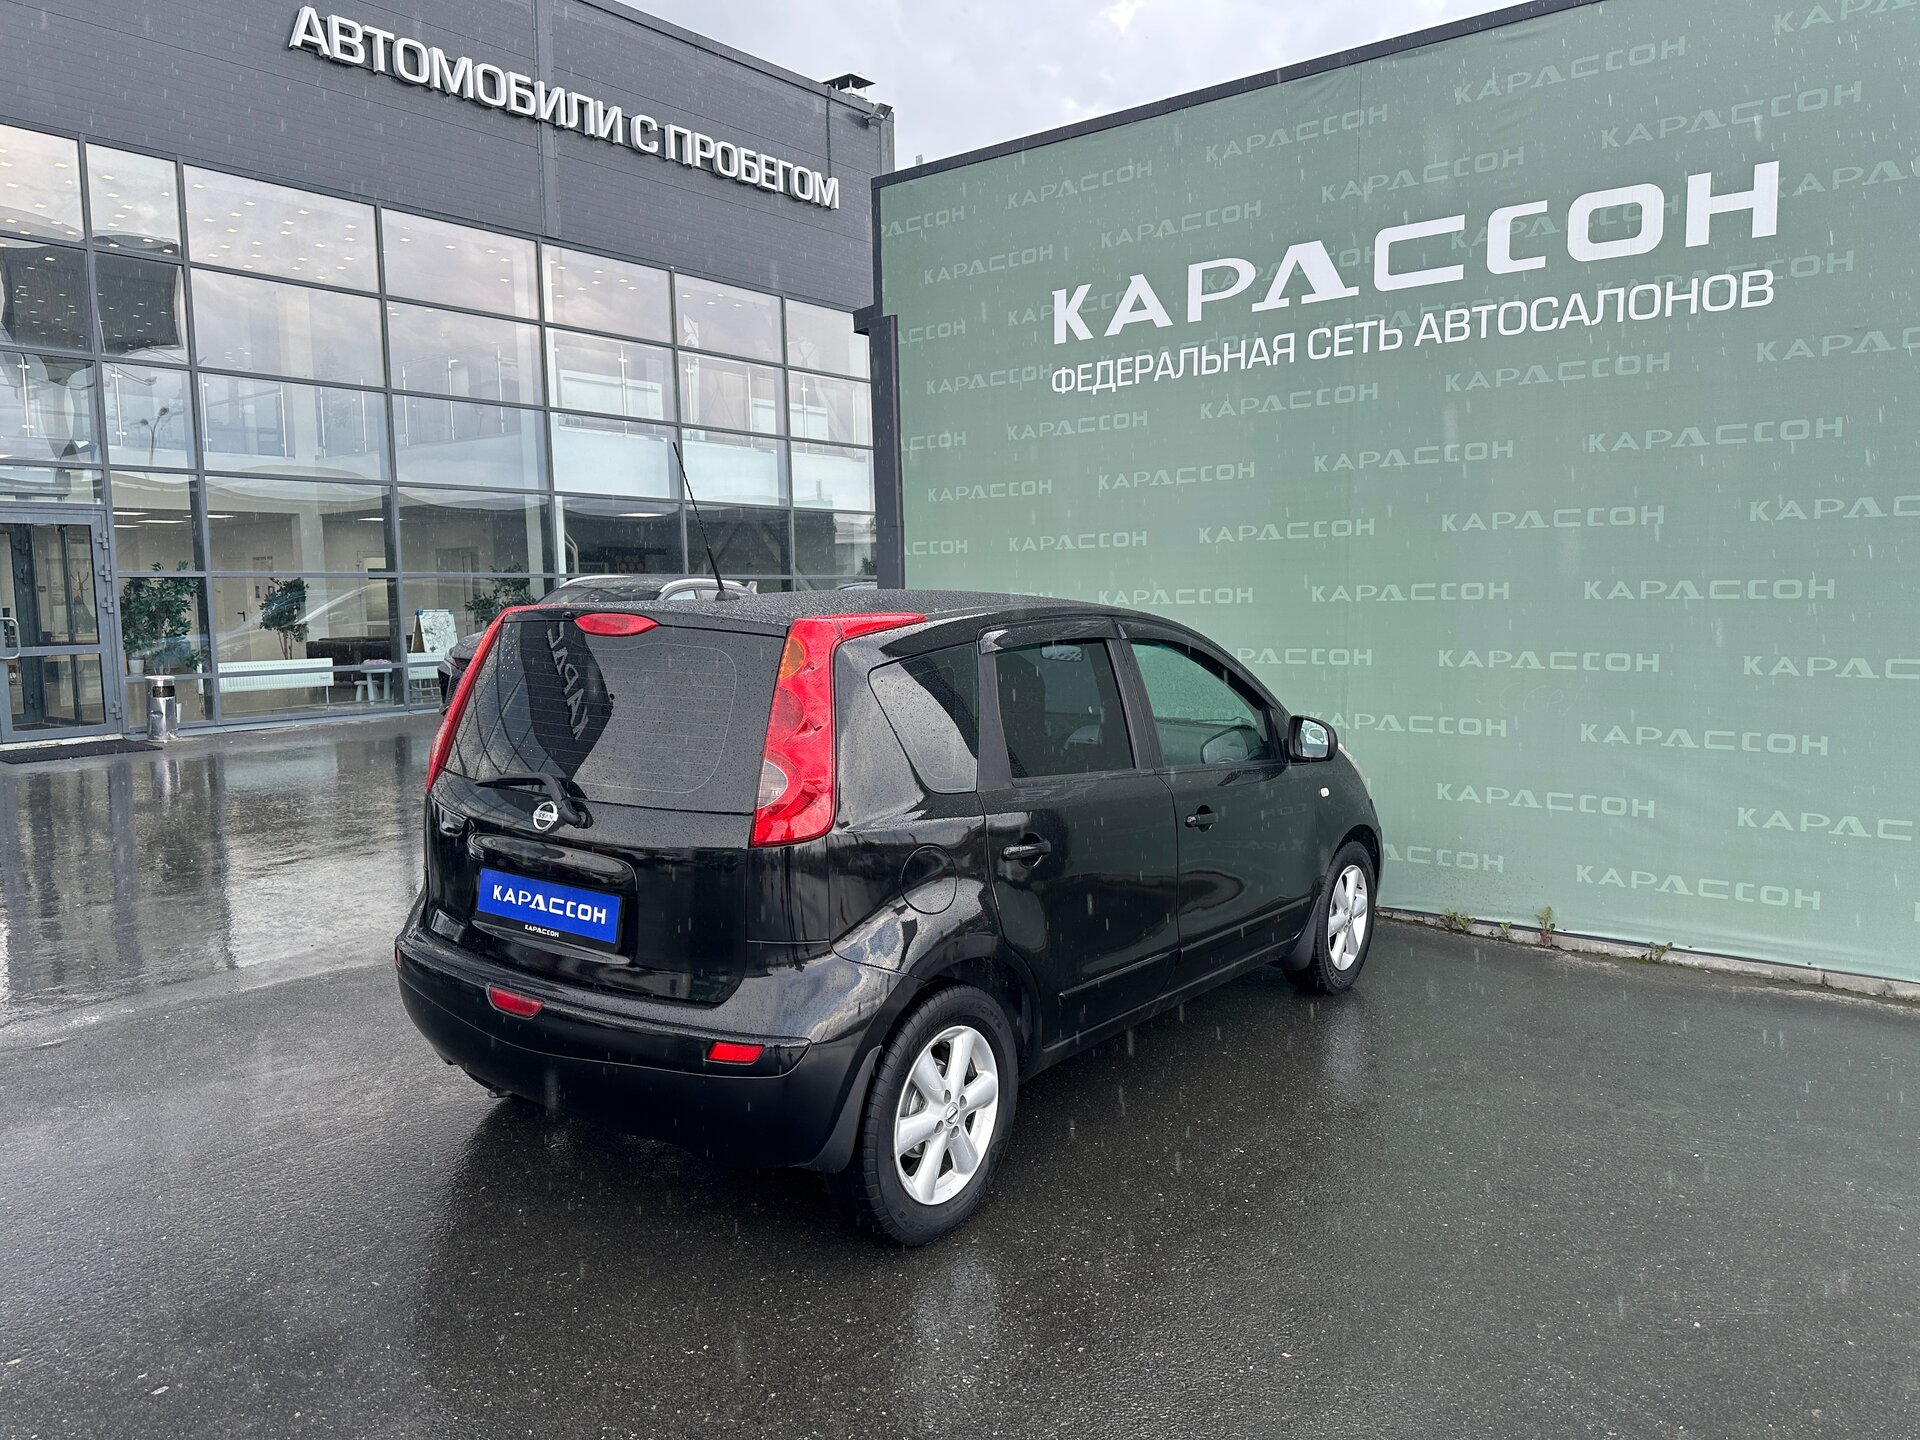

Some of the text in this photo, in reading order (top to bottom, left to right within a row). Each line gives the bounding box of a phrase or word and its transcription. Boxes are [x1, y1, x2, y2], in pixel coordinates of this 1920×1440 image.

[288, 5, 840, 210] АВТОМОБИЛИ С ПРОБЕГОМ
[1050, 331, 1297, 395] ФЕДЕРАЛЬНАЯ
[1306, 318, 1403, 361] СЕТЬ
[1414, 268, 1775, 348] АВТОСАЛОНОВ
